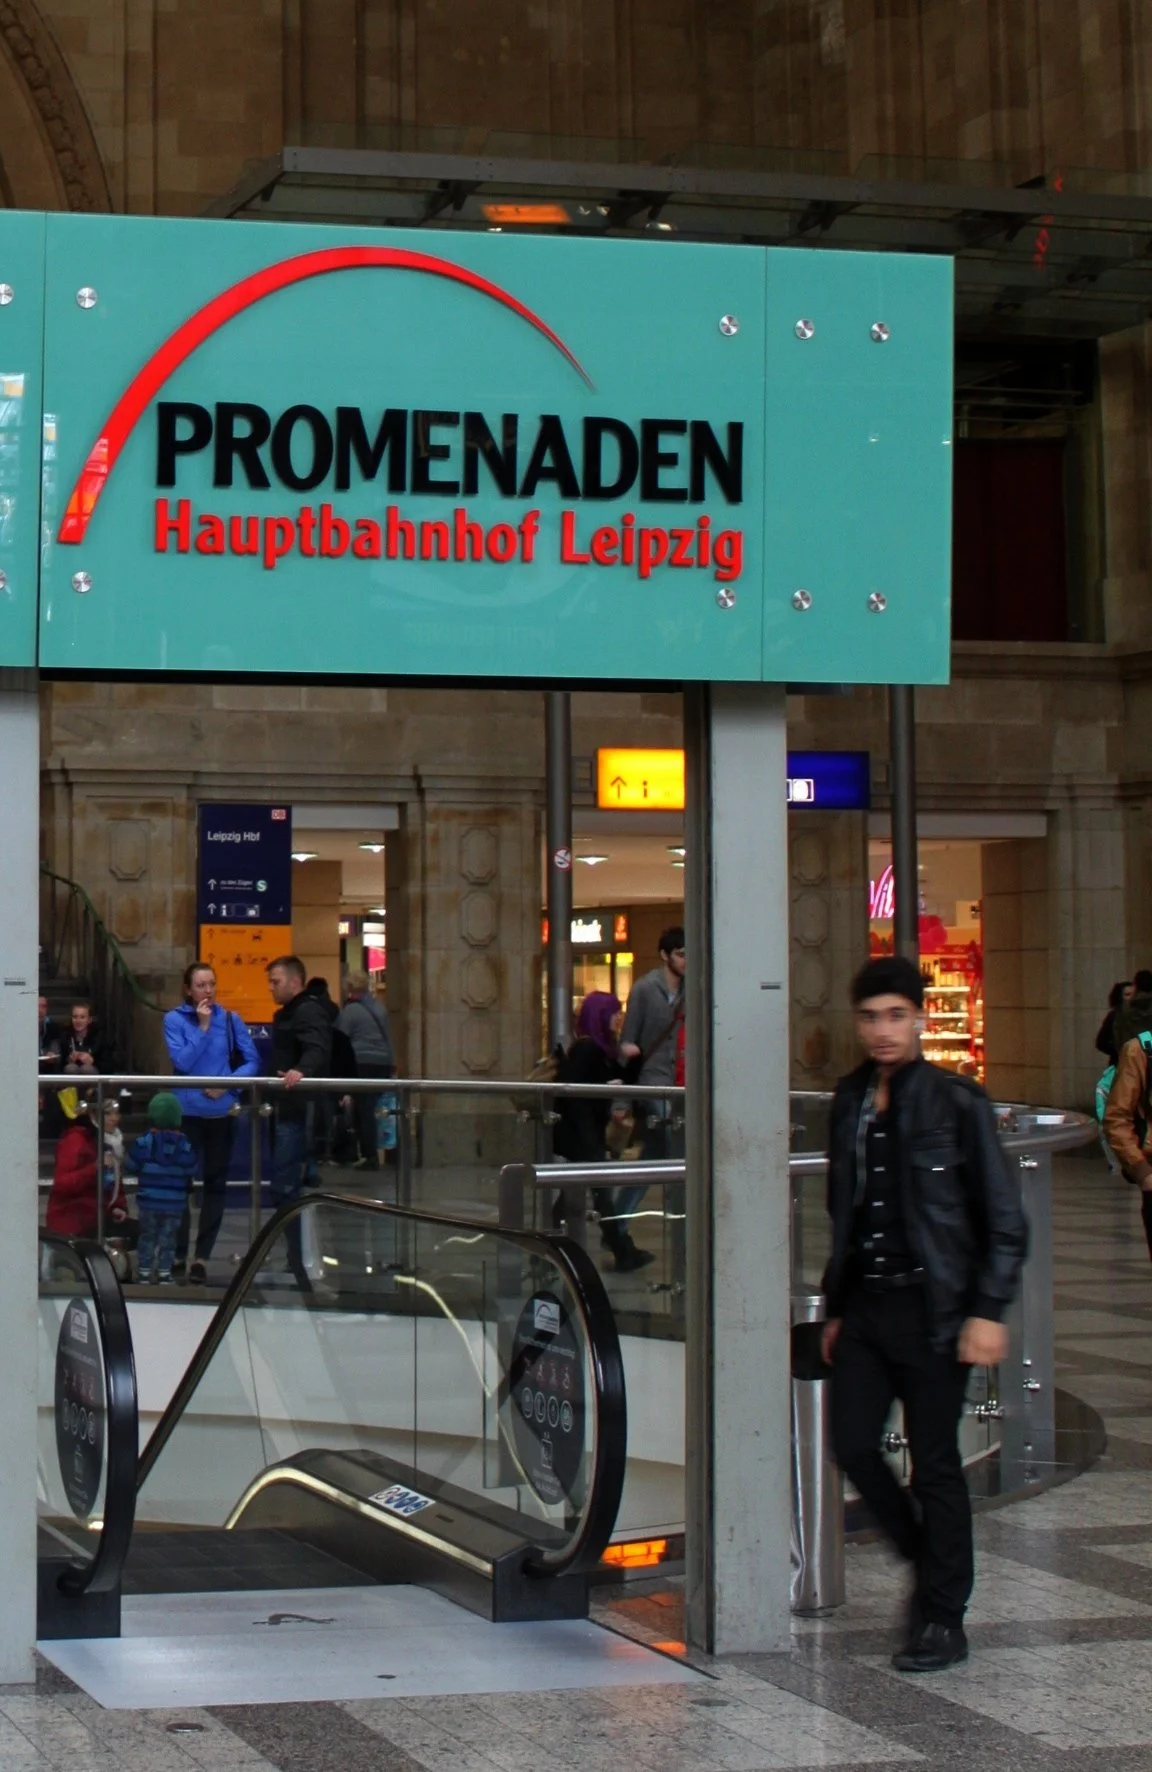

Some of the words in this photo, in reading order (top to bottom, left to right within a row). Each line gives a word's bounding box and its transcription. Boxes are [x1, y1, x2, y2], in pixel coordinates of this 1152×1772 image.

[154, 401, 743, 503] PROMENADEN
[154, 498, 541, 569] Hauptbahnhof
[560, 510, 743, 581] Leipzig
[207, 830, 241, 843] Leipzig
[243, 831, 260, 841] Hbf
